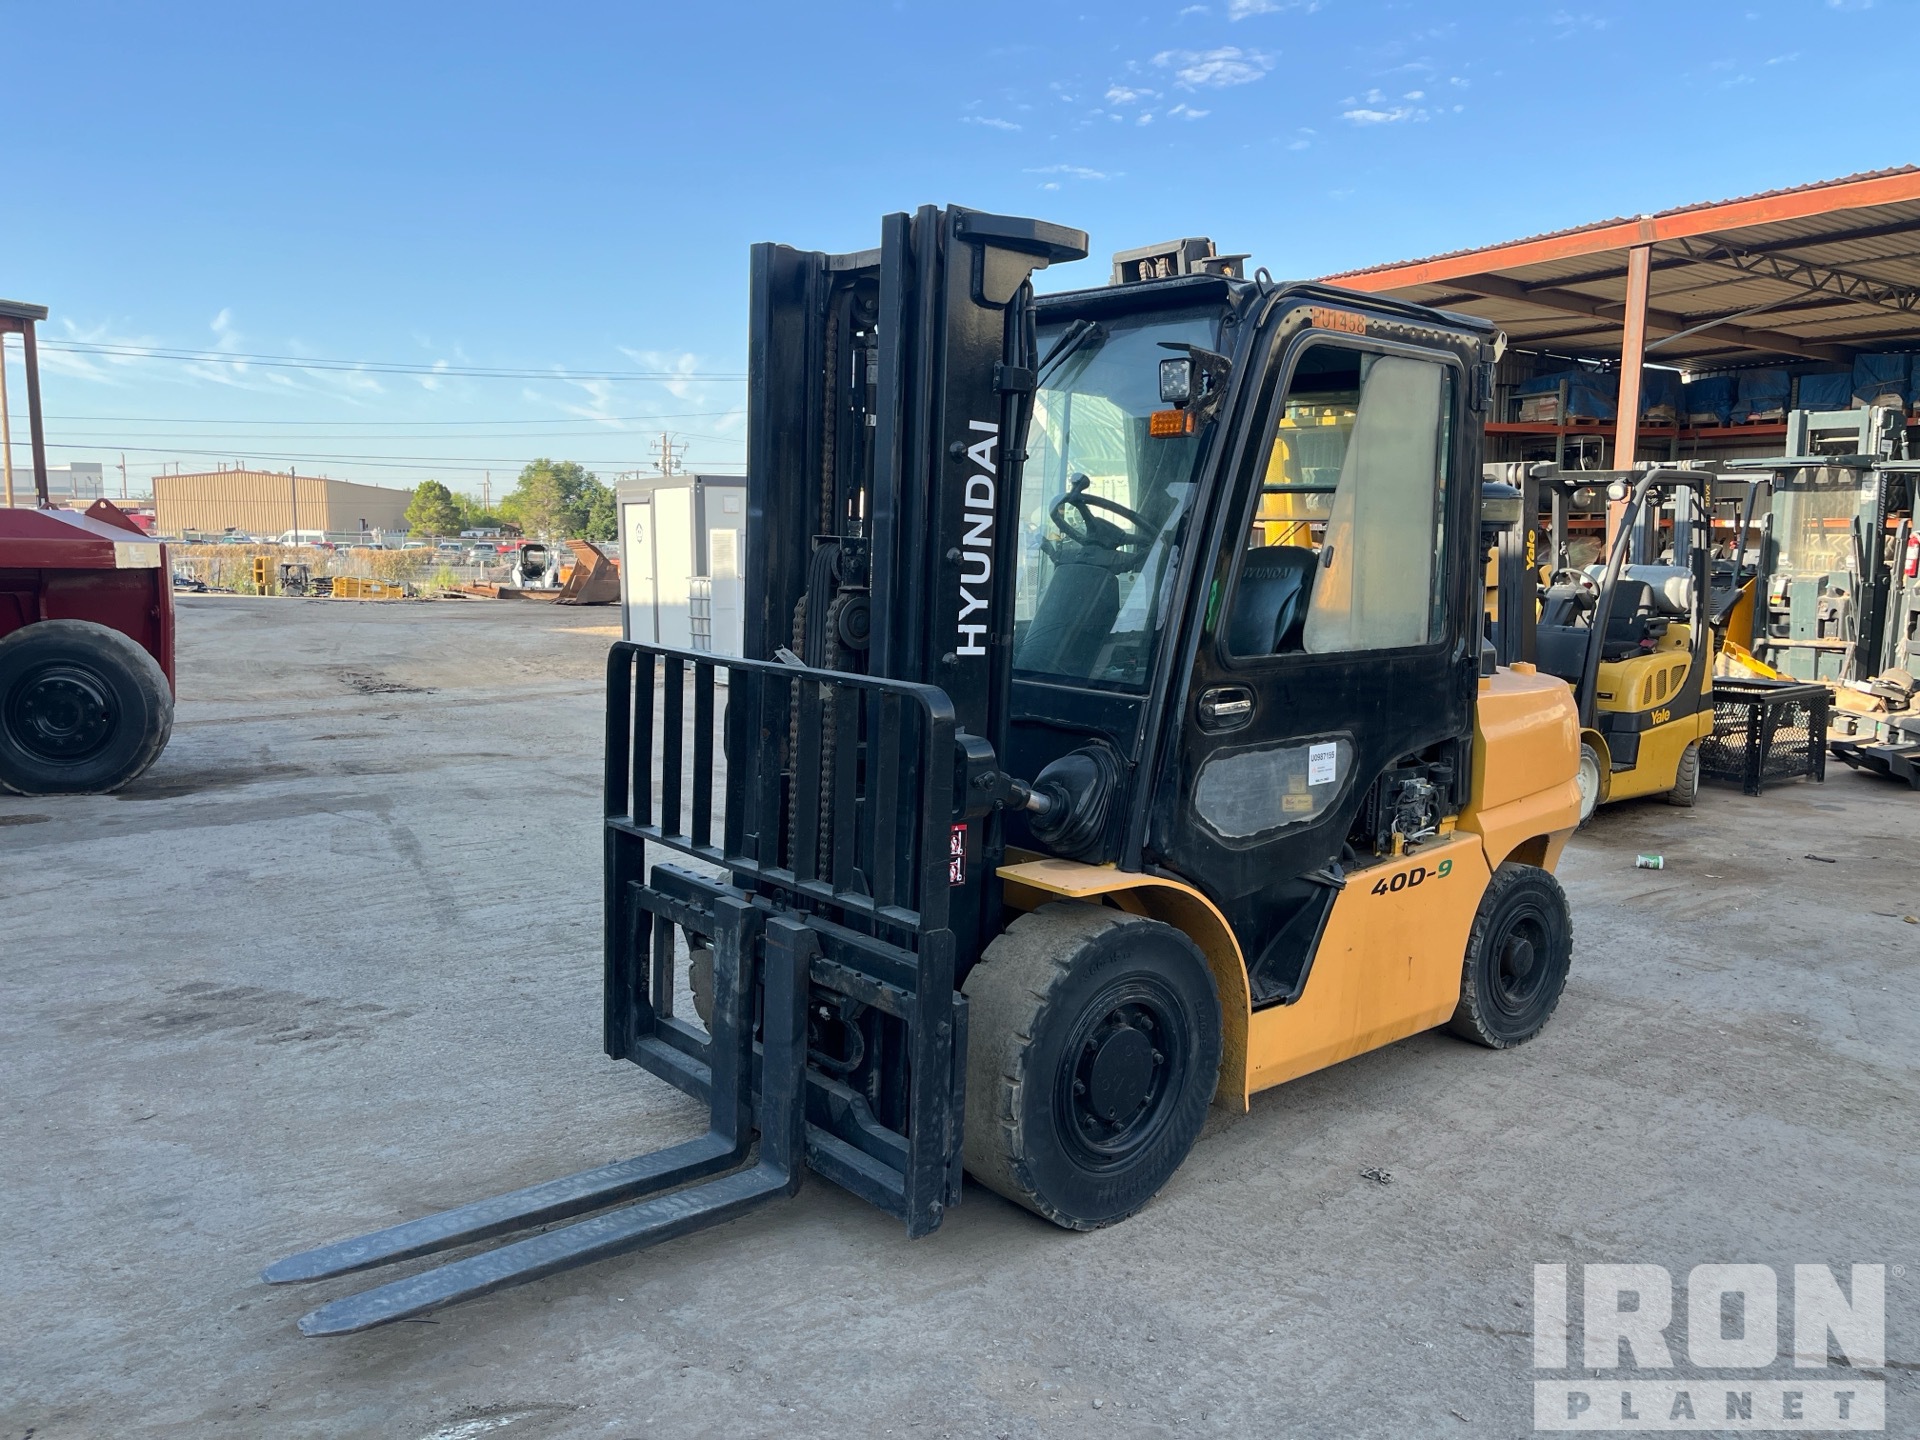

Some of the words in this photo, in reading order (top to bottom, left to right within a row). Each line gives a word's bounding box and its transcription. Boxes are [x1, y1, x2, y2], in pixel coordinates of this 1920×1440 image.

[1313, 307, 1365, 334] PU1458
[956, 419, 999, 656] HYUNDAI
[1526, 530, 1536, 571] Yale
[1651, 708, 1671, 726] Yale
[1371, 859, 1453, 896] 40D-9
